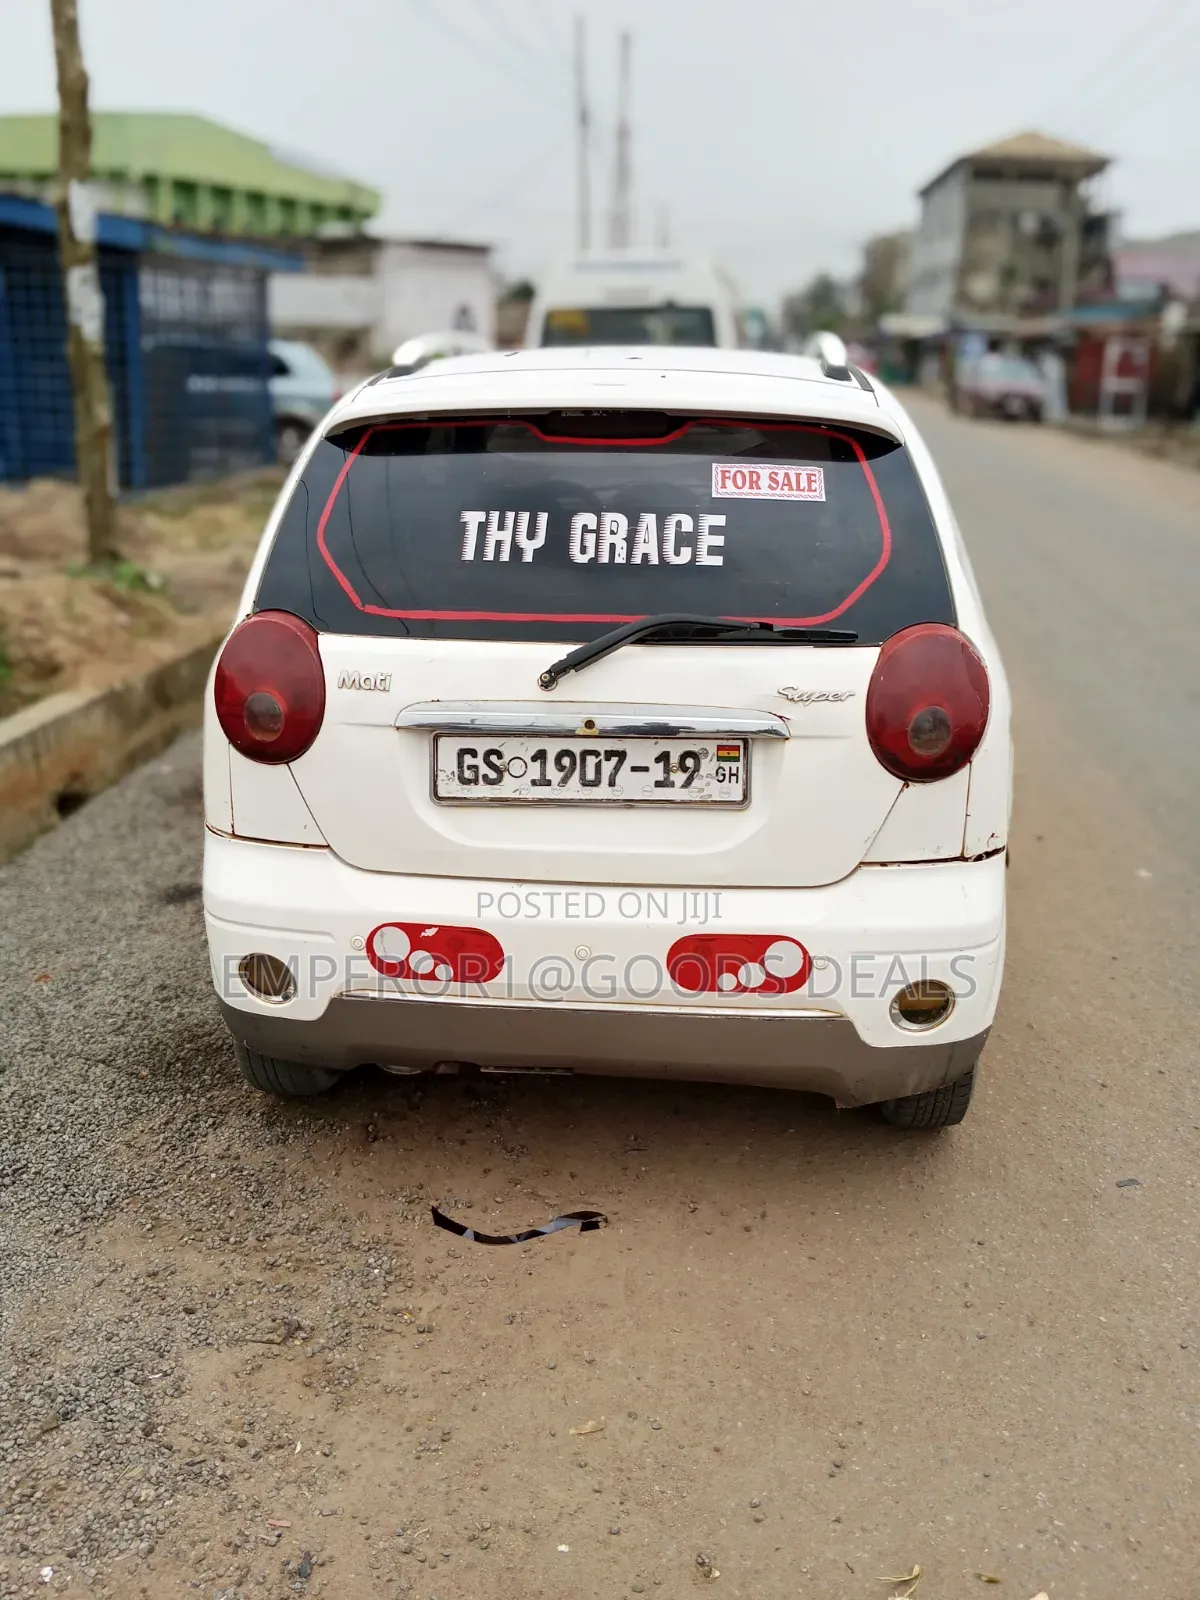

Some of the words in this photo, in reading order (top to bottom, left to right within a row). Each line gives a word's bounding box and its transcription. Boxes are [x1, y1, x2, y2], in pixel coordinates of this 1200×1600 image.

[720, 470, 761, 489] FOR
[767, 471, 817, 492] SALE
[460, 511, 548, 562] THY
[569, 512, 727, 566] GRACE
[338, 669, 392, 692] Mati
[777, 684, 856, 707] Super
[457, 747, 505, 786] GS
[530, 748, 701, 789] 1907-19
[715, 766, 739, 784] GH
